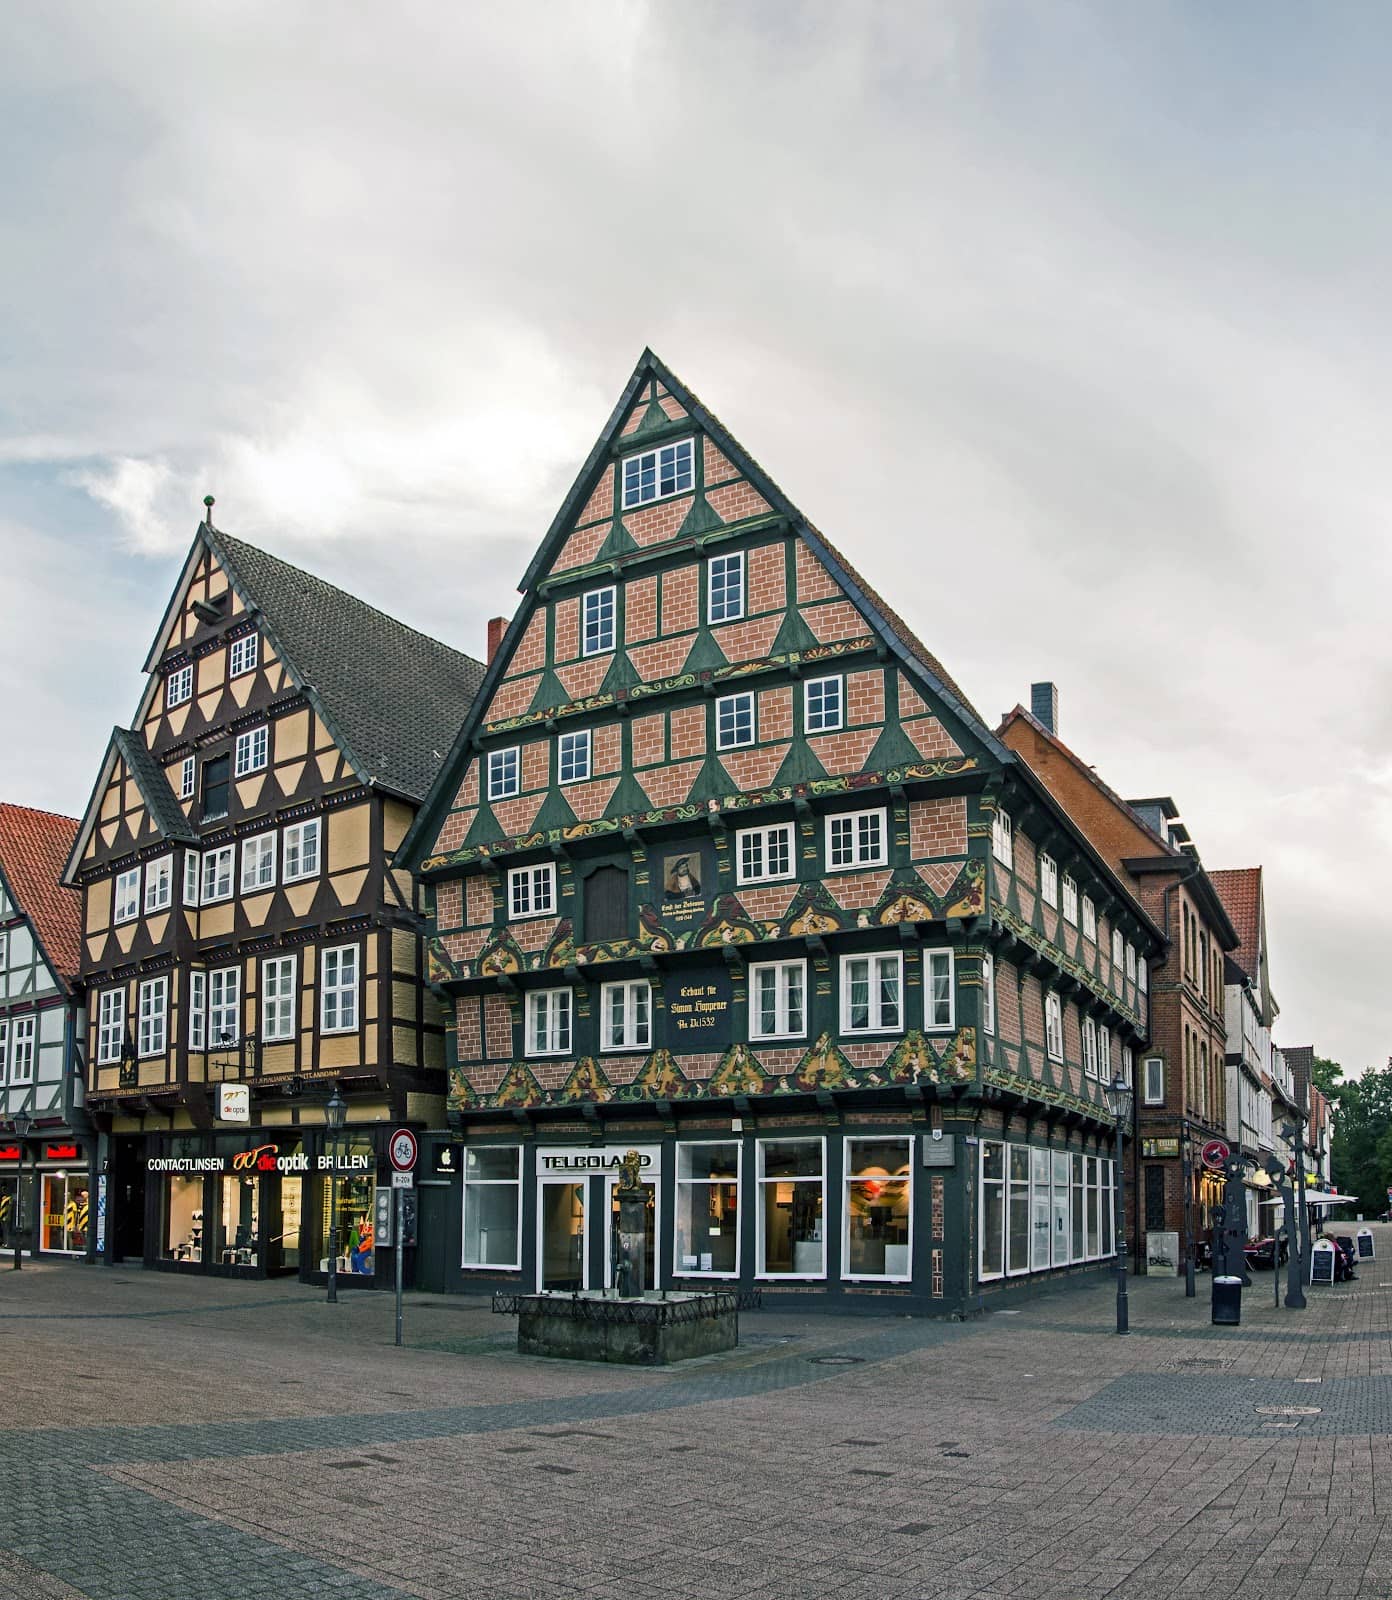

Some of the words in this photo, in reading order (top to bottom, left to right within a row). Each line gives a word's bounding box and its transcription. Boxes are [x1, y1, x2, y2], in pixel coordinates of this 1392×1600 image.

[700, 1016, 715, 1027] 1532
[103, 1160, 108, 1169] 7
[147, 1158, 224, 1171] CONTACTLINSEN
[257, 1154, 276, 1171] die
[277, 1152, 309, 1175] optik
[317, 1155, 368, 1169] BRILLEN
[541, 1155, 652, 1169] TELCOLAD
